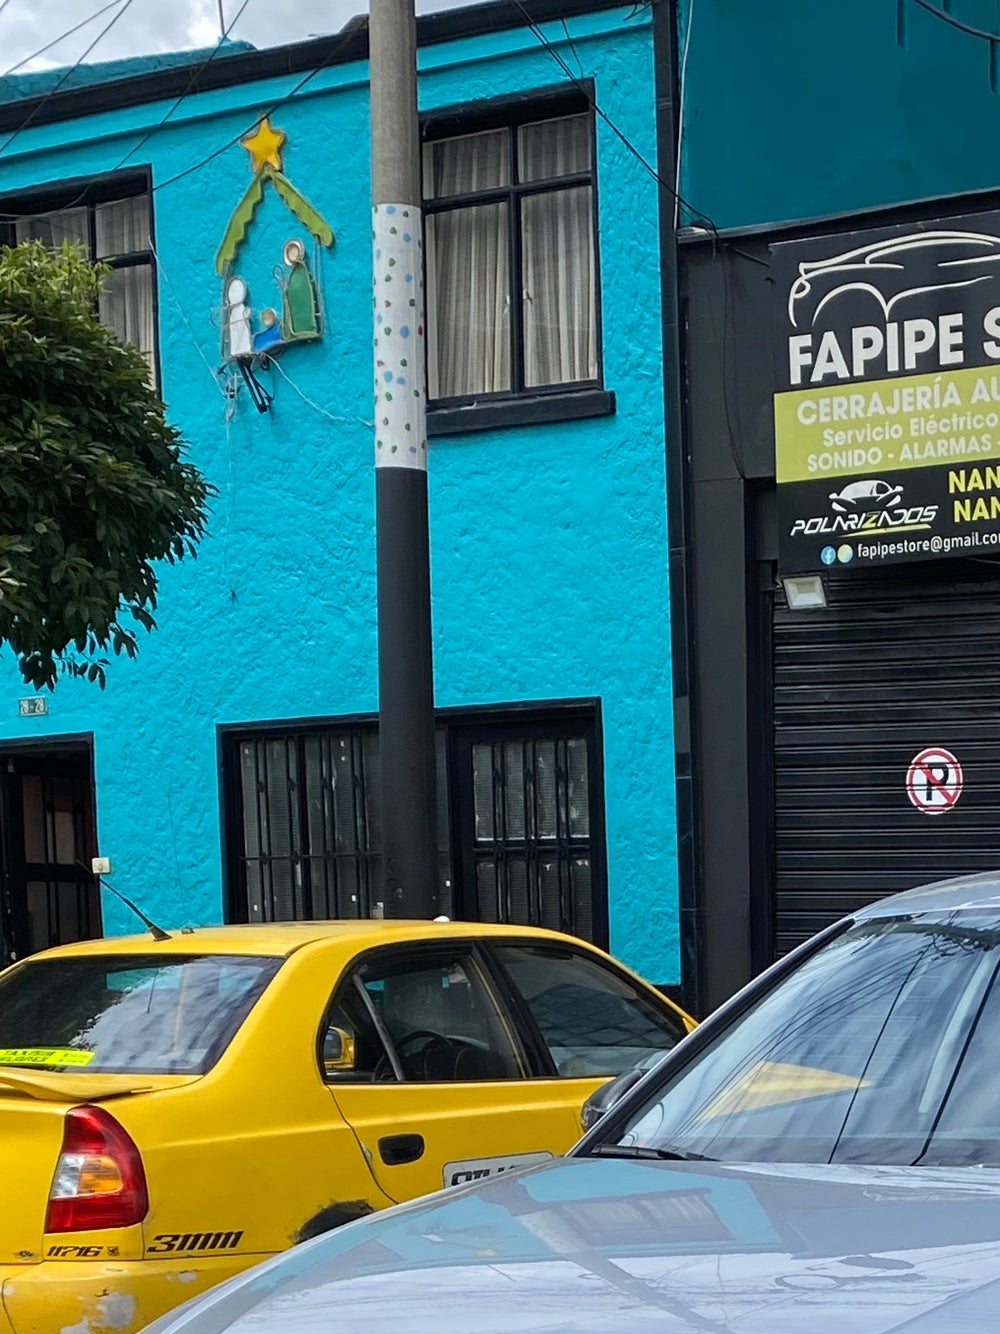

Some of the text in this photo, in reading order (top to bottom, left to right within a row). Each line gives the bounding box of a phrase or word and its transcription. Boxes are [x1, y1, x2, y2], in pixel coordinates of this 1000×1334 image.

[788, 312, 965, 385] FAPIPE
[797, 376, 962, 425] CERRAJERÍA
[823, 421, 903, 448] Servicio
[910, 411, 1000, 438] Eléctrico
[807, 447, 882, 473] SONIDO
[899, 433, 993, 462] ALARMAS
[790, 505, 939, 537] POLARIZADOS
